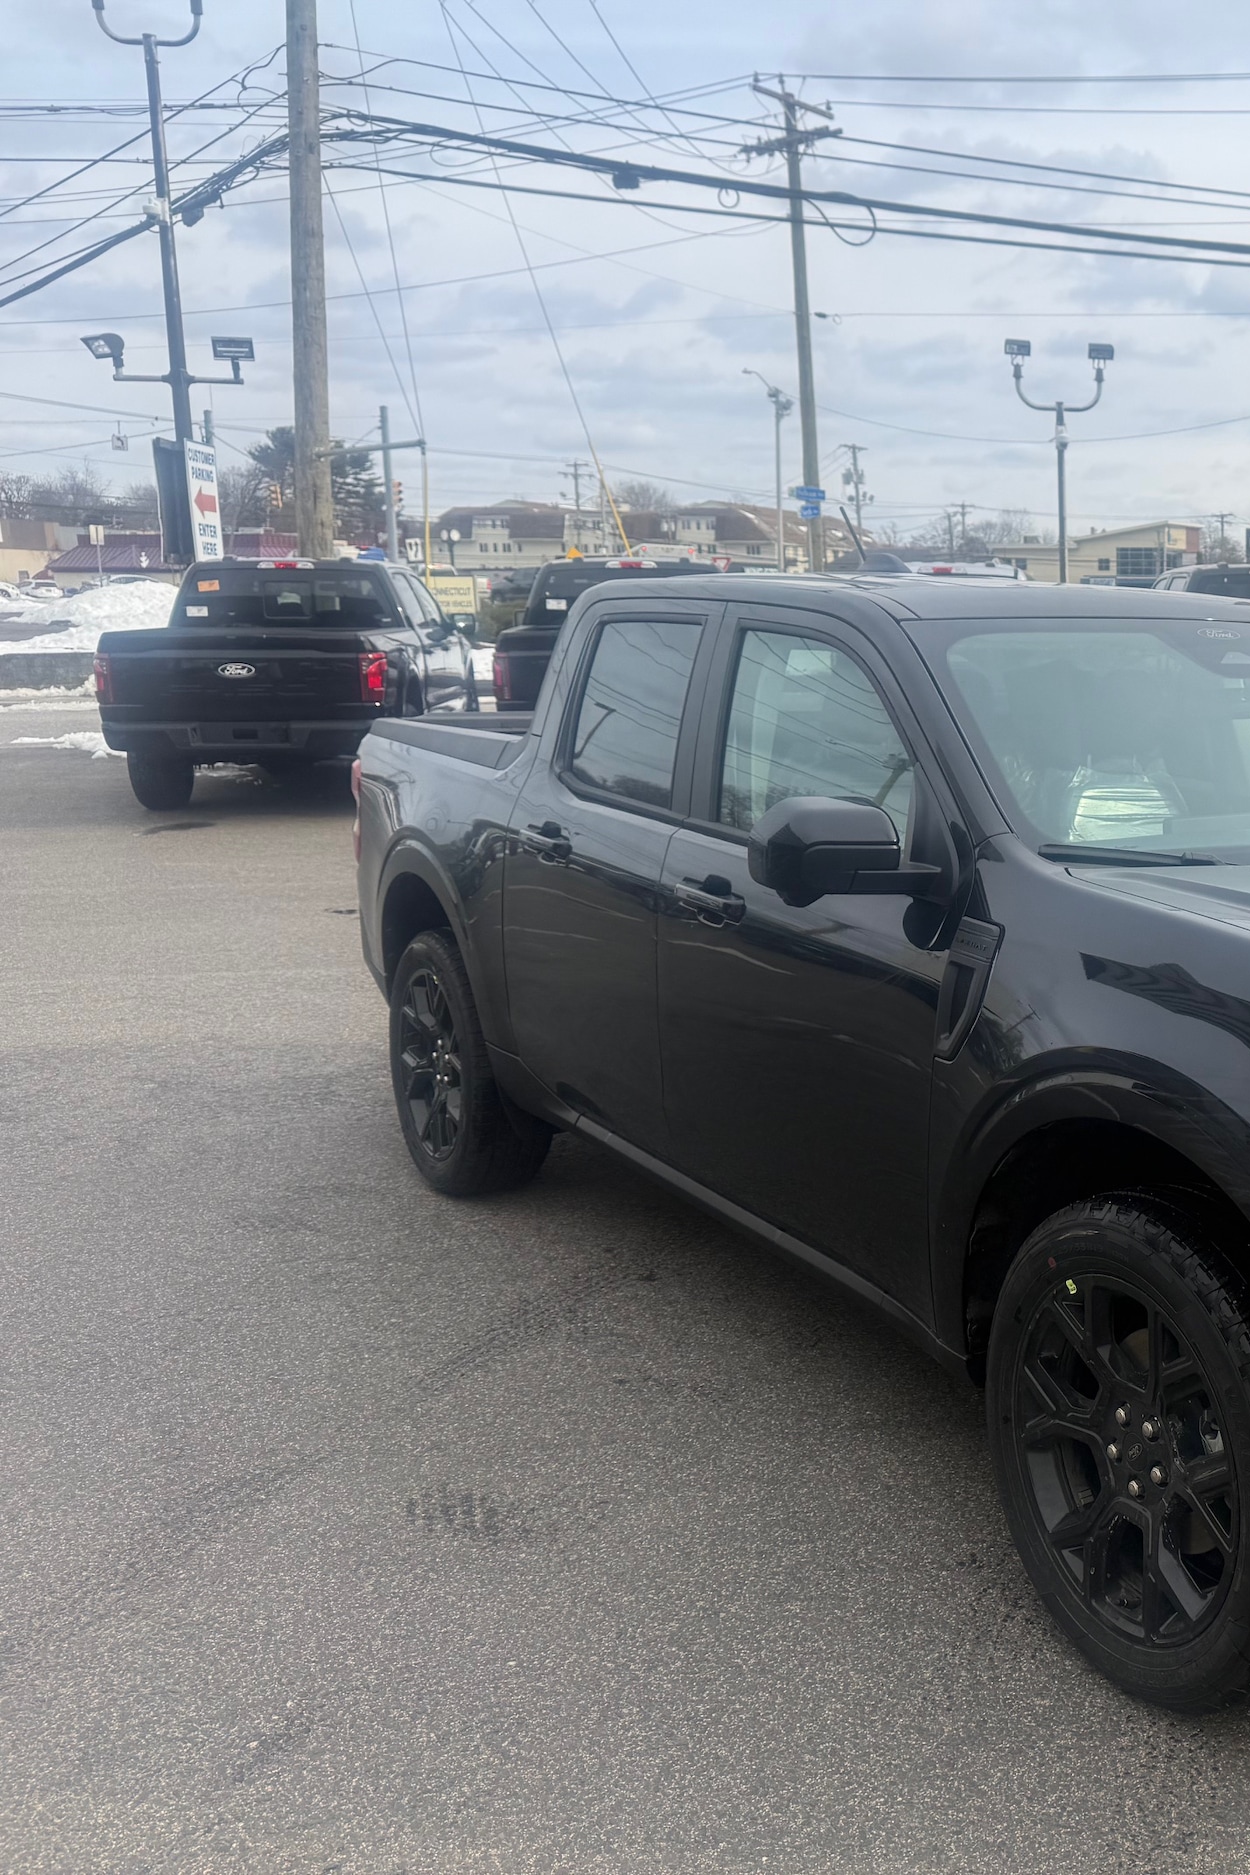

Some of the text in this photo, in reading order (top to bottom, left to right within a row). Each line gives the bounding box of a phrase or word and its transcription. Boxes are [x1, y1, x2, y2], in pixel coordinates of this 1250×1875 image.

[188, 448, 214, 466] CUSTOMER
[191, 466, 214, 482] PARKING
[198, 523, 217, 538] ENTER
[202, 542, 218, 556] HERE
[223, 663, 249, 677] Ford
